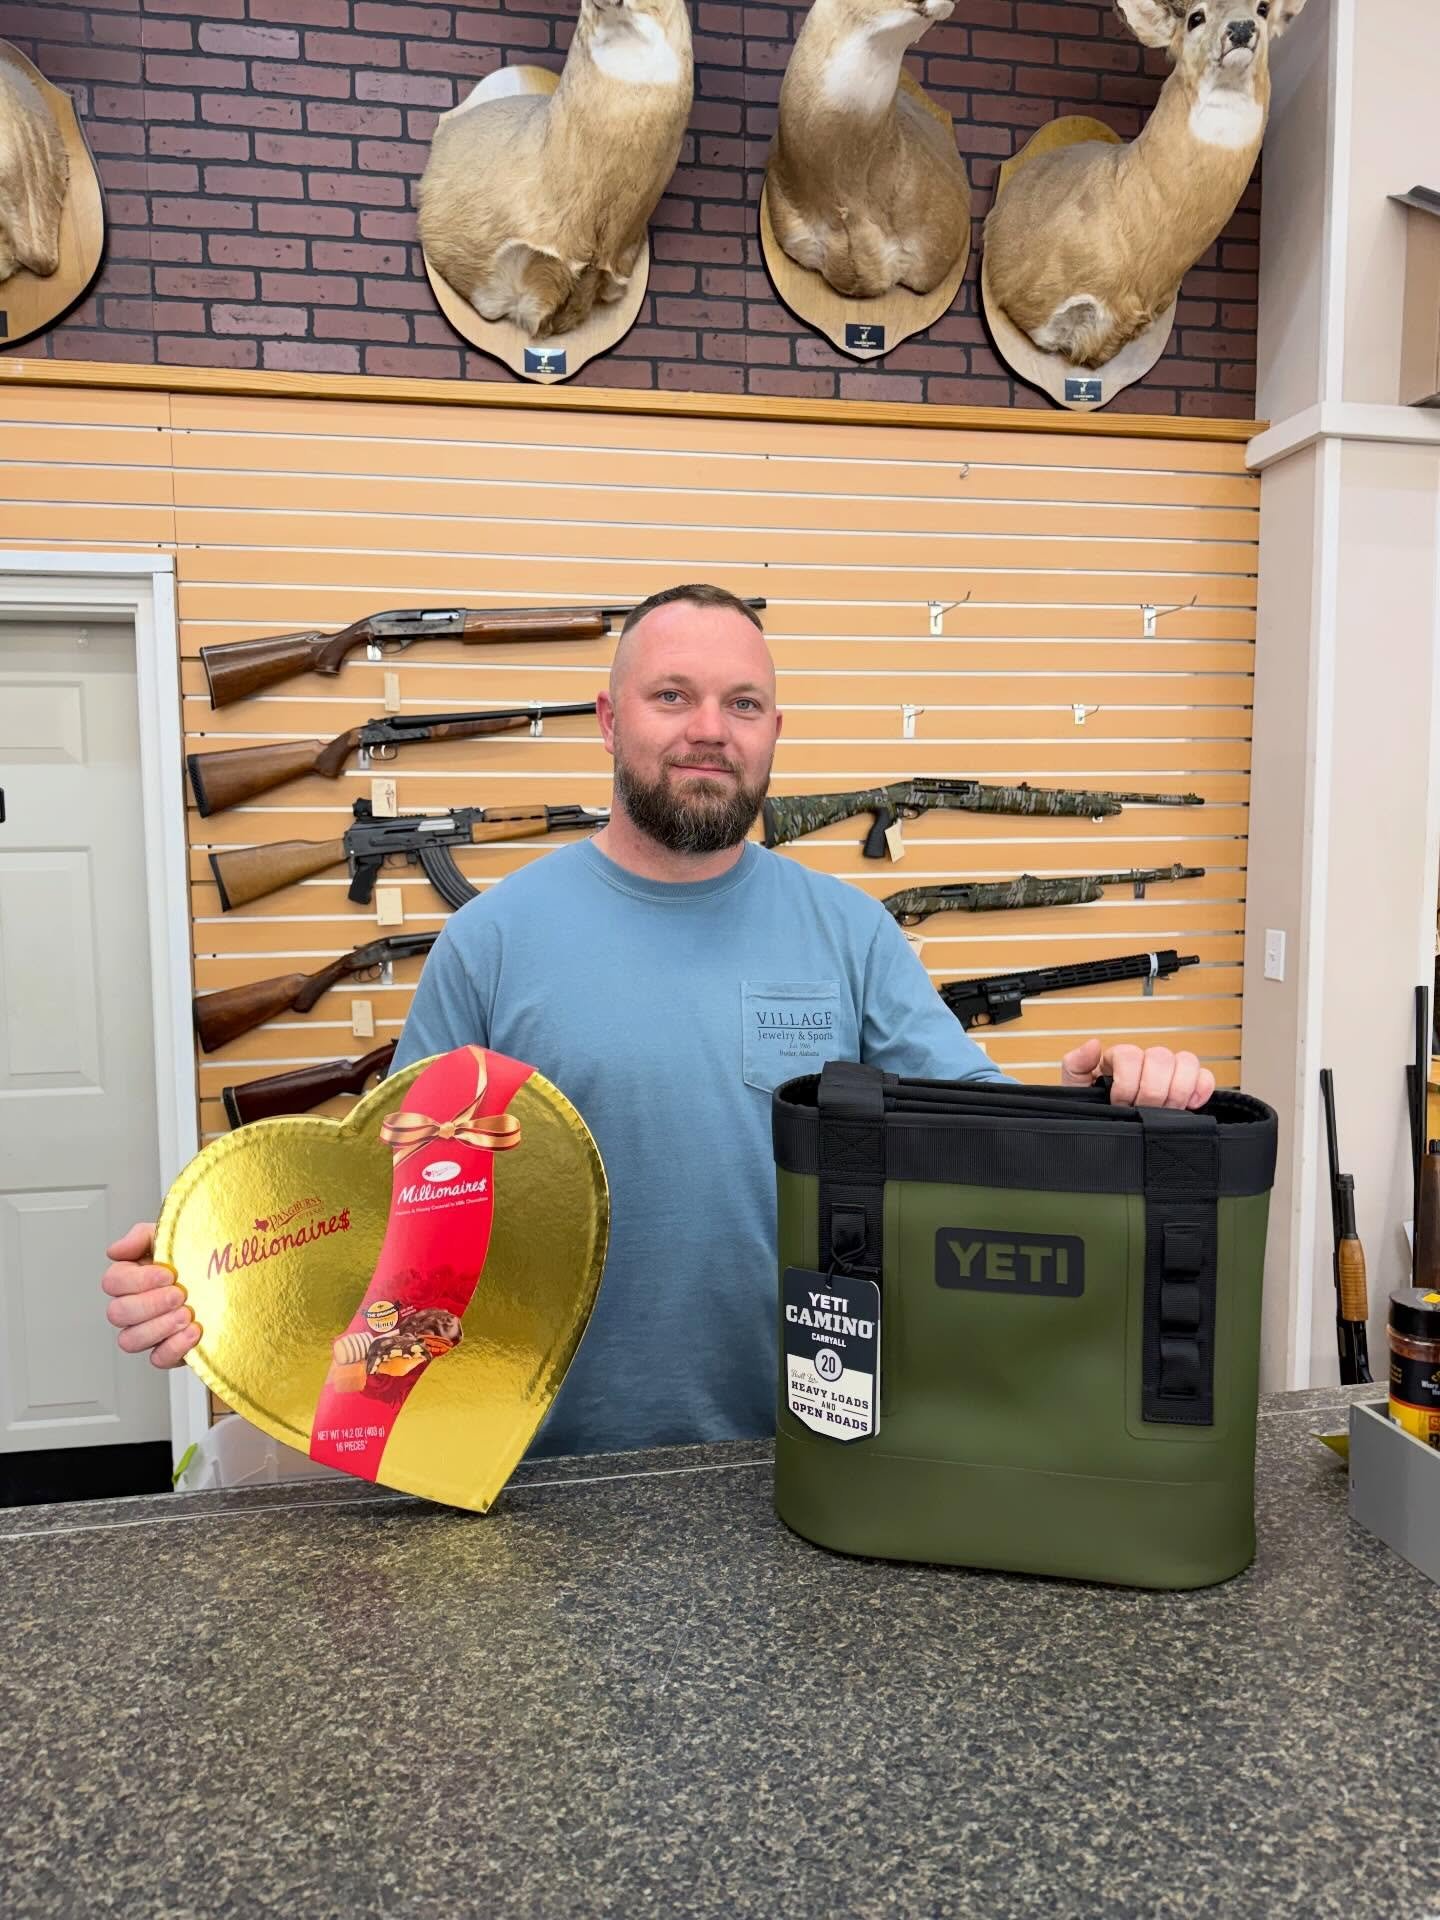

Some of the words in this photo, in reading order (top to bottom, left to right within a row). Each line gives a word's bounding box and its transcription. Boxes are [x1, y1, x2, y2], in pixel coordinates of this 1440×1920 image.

[756, 1012, 832, 1026] VILLAGE
[758, 1030, 795, 1044] Jewelry
[798, 1031, 805, 1040] &
[807, 1031, 834, 1043] Sports
[946, 1240, 1068, 1285] YETI
[808, 1291, 849, 1313] YETI
[785, 1304, 873, 1340] CAMINO
[811, 1333, 847, 1348] CARRYALL
[821, 1355, 836, 1374] 20
[791, 1380, 828, 1399] HEAVY
[831, 1391, 869, 1410] LOADS
[821, 1400, 836, 1411] AND
[792, 1401, 823, 1419] OPEN
[826, 1412, 868, 1432] ROADS
[317, 1430, 329, 1440] NET
[330, 1429, 340, 1440] WT
[354, 1427, 364, 1438] OZ
[335, 1442, 344, 1452] 16
